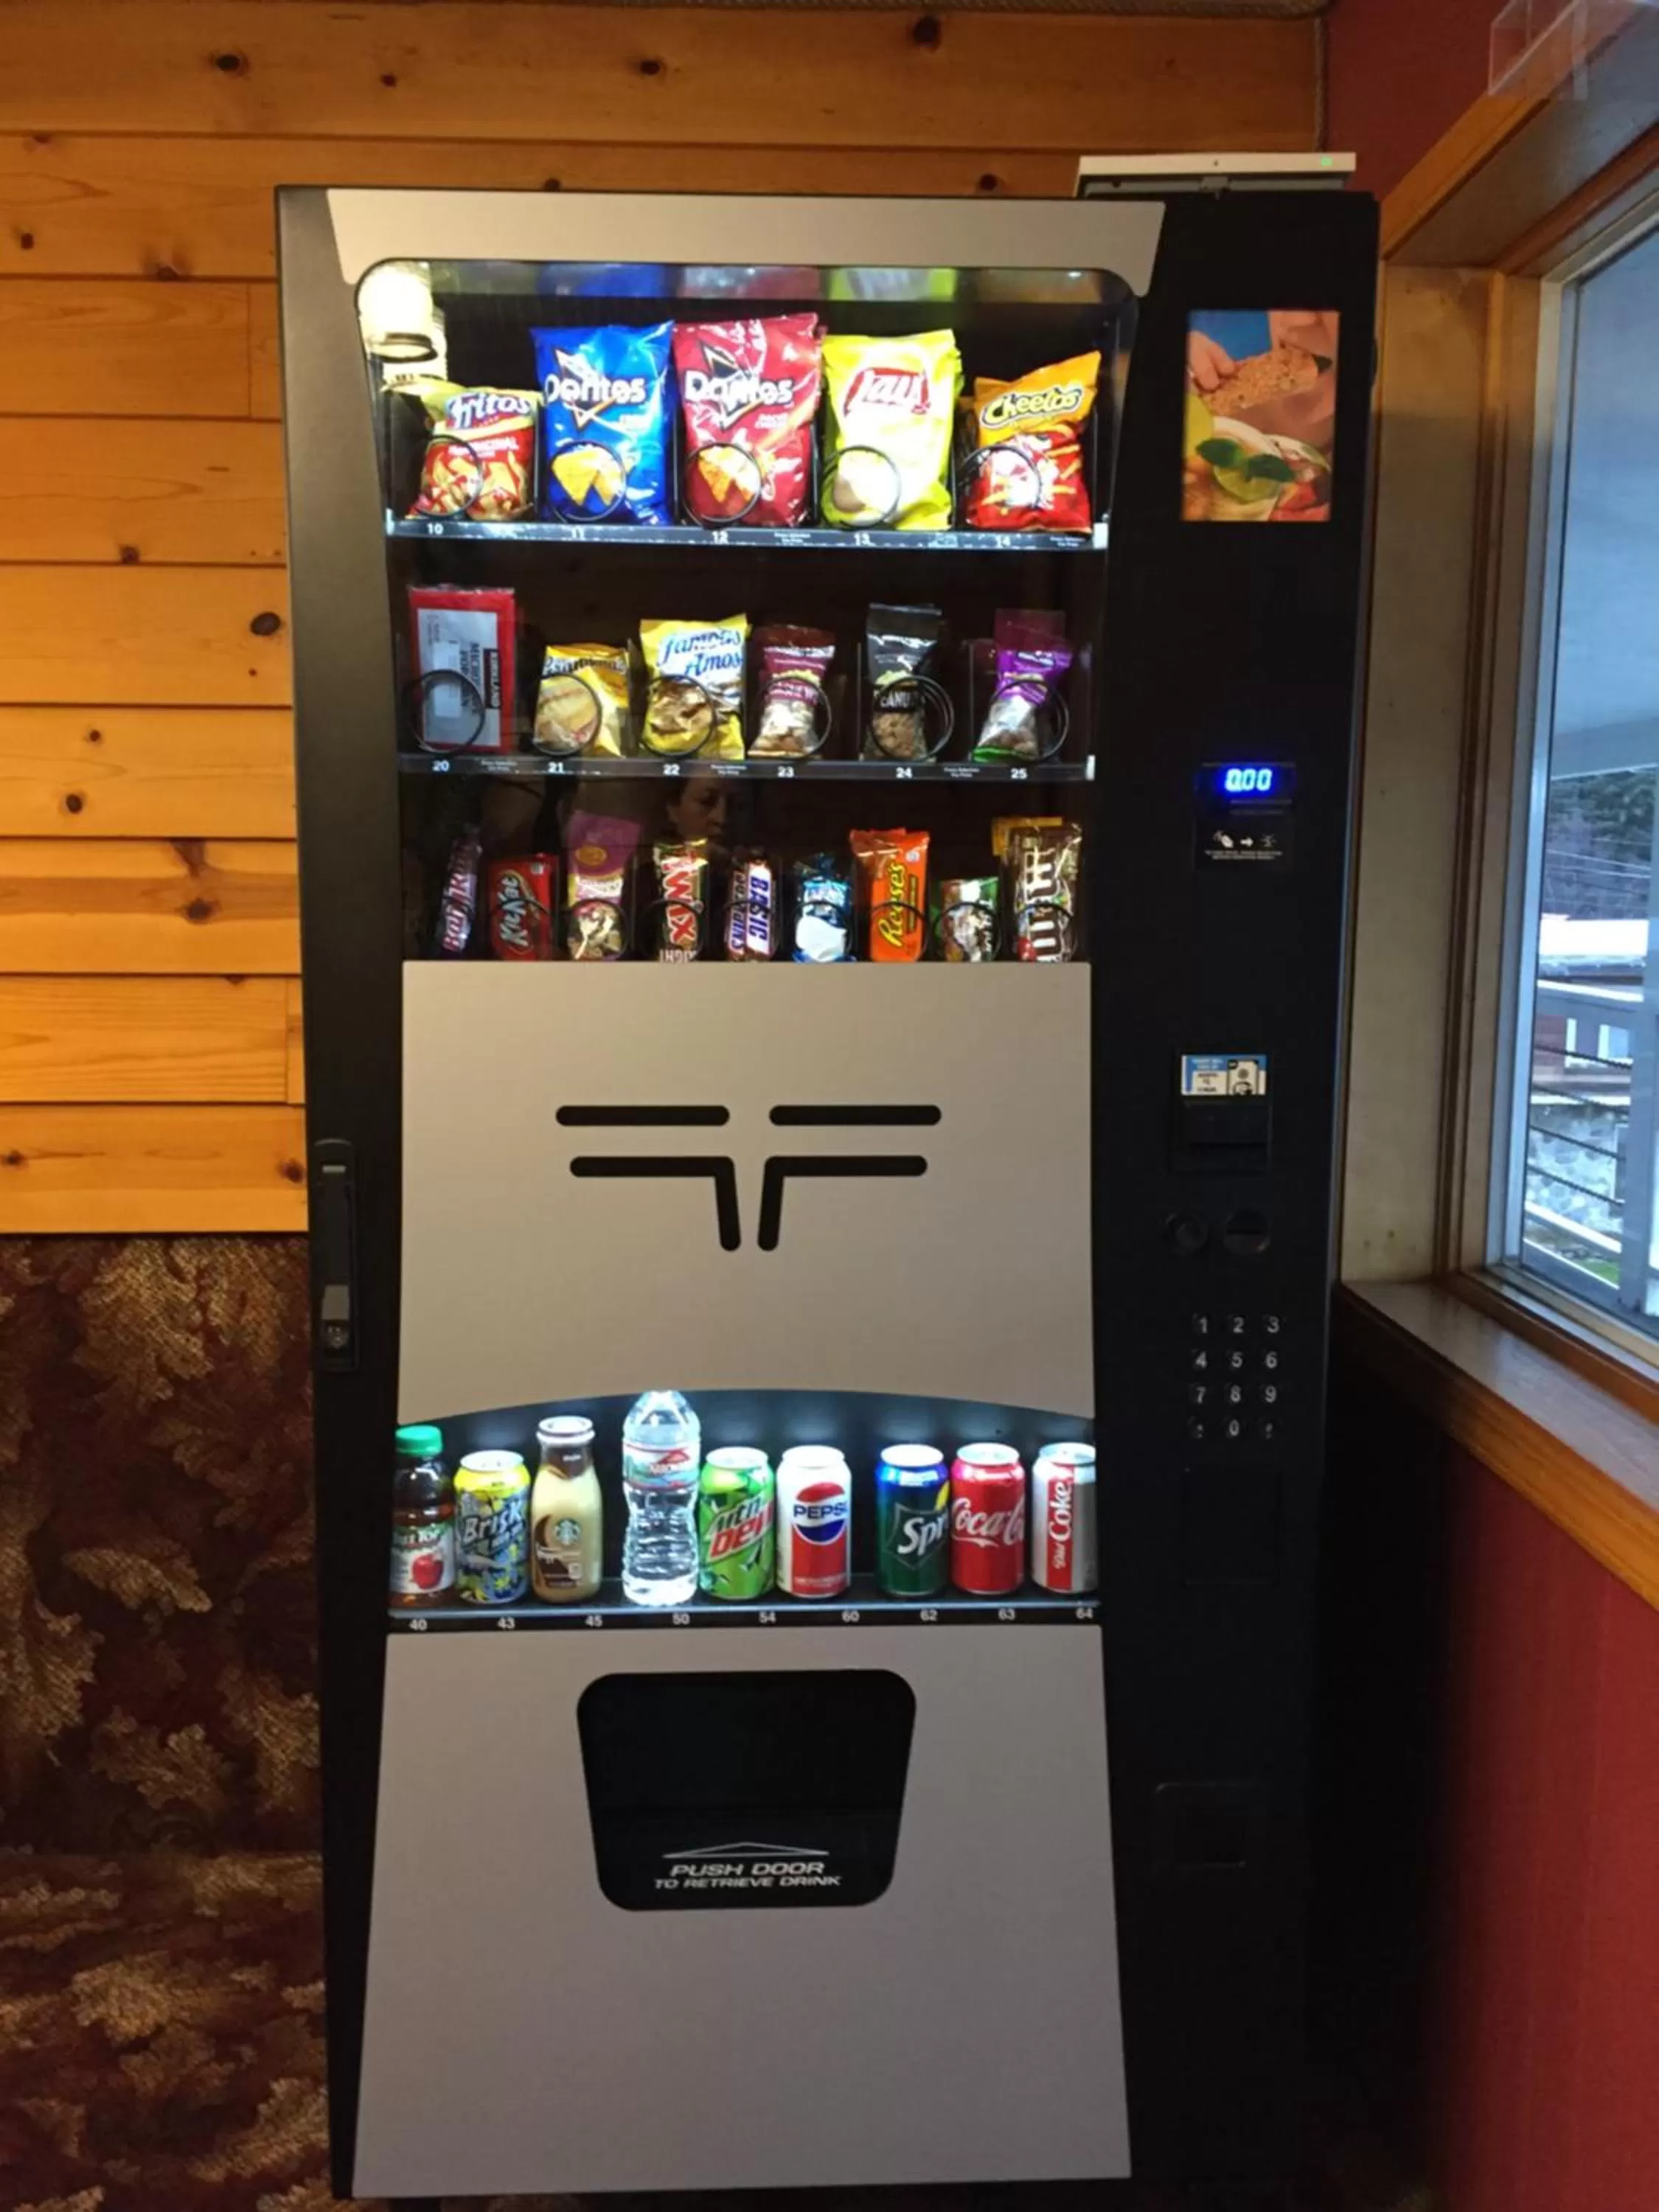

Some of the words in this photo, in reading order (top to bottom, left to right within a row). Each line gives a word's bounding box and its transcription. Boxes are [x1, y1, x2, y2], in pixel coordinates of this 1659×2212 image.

[447, 392, 532, 429] Fritos
[983, 384, 1082, 426] Cheetos
[426, 522, 444, 535] 10
[571, 526, 585, 540] 11
[684, 653, 743, 676] Amos
[432, 760, 450, 772] 20
[548, 761, 564, 773] 21
[664, 764, 680, 775] 22
[777, 766, 794, 778] 23
[896, 767, 913, 779] 24
[1011, 768, 1027, 779] 25
[877, 861, 906, 947] Reese's
[1200, 1316, 1208, 1333] 1
[1232, 1316, 1244, 1333] 2
[1267, 1316, 1280, 1333] 3
[1195, 1352, 1208, 1368] 4
[1231, 1352, 1243, 1368] 5
[1265, 1351, 1278, 1368] 6
[1197, 1385, 1206, 1404] 7
[1230, 1385, 1242, 1403] 8
[1265, 1385, 1277, 1403] 9
[1229, 1419, 1240, 1436] 0
[793, 1502, 848, 1520] PEPS
[1049, 1481, 1072, 1542] Coke
[463, 1498, 523, 1545] Brisk
[672, 1613, 690, 1624] 50
[759, 1611, 776, 1623] 54
[842, 1610, 860, 1622] 60
[920, 1610, 938, 1621] 62
[998, 1608, 1015, 1620] 63
[1076, 1607, 1093, 1618] 64
[409, 1618, 428, 1630] 40
[498, 1617, 515, 1629] 43
[585, 1615, 603, 1627] 45
[669, 1863, 745, 1877] PUSH
[751, 1861, 825, 1875] DOOR
[654, 1878, 679, 1890] TO
[683, 1876, 774, 1888] RETRIEVE
[779, 1875, 842, 1887] DRINK
